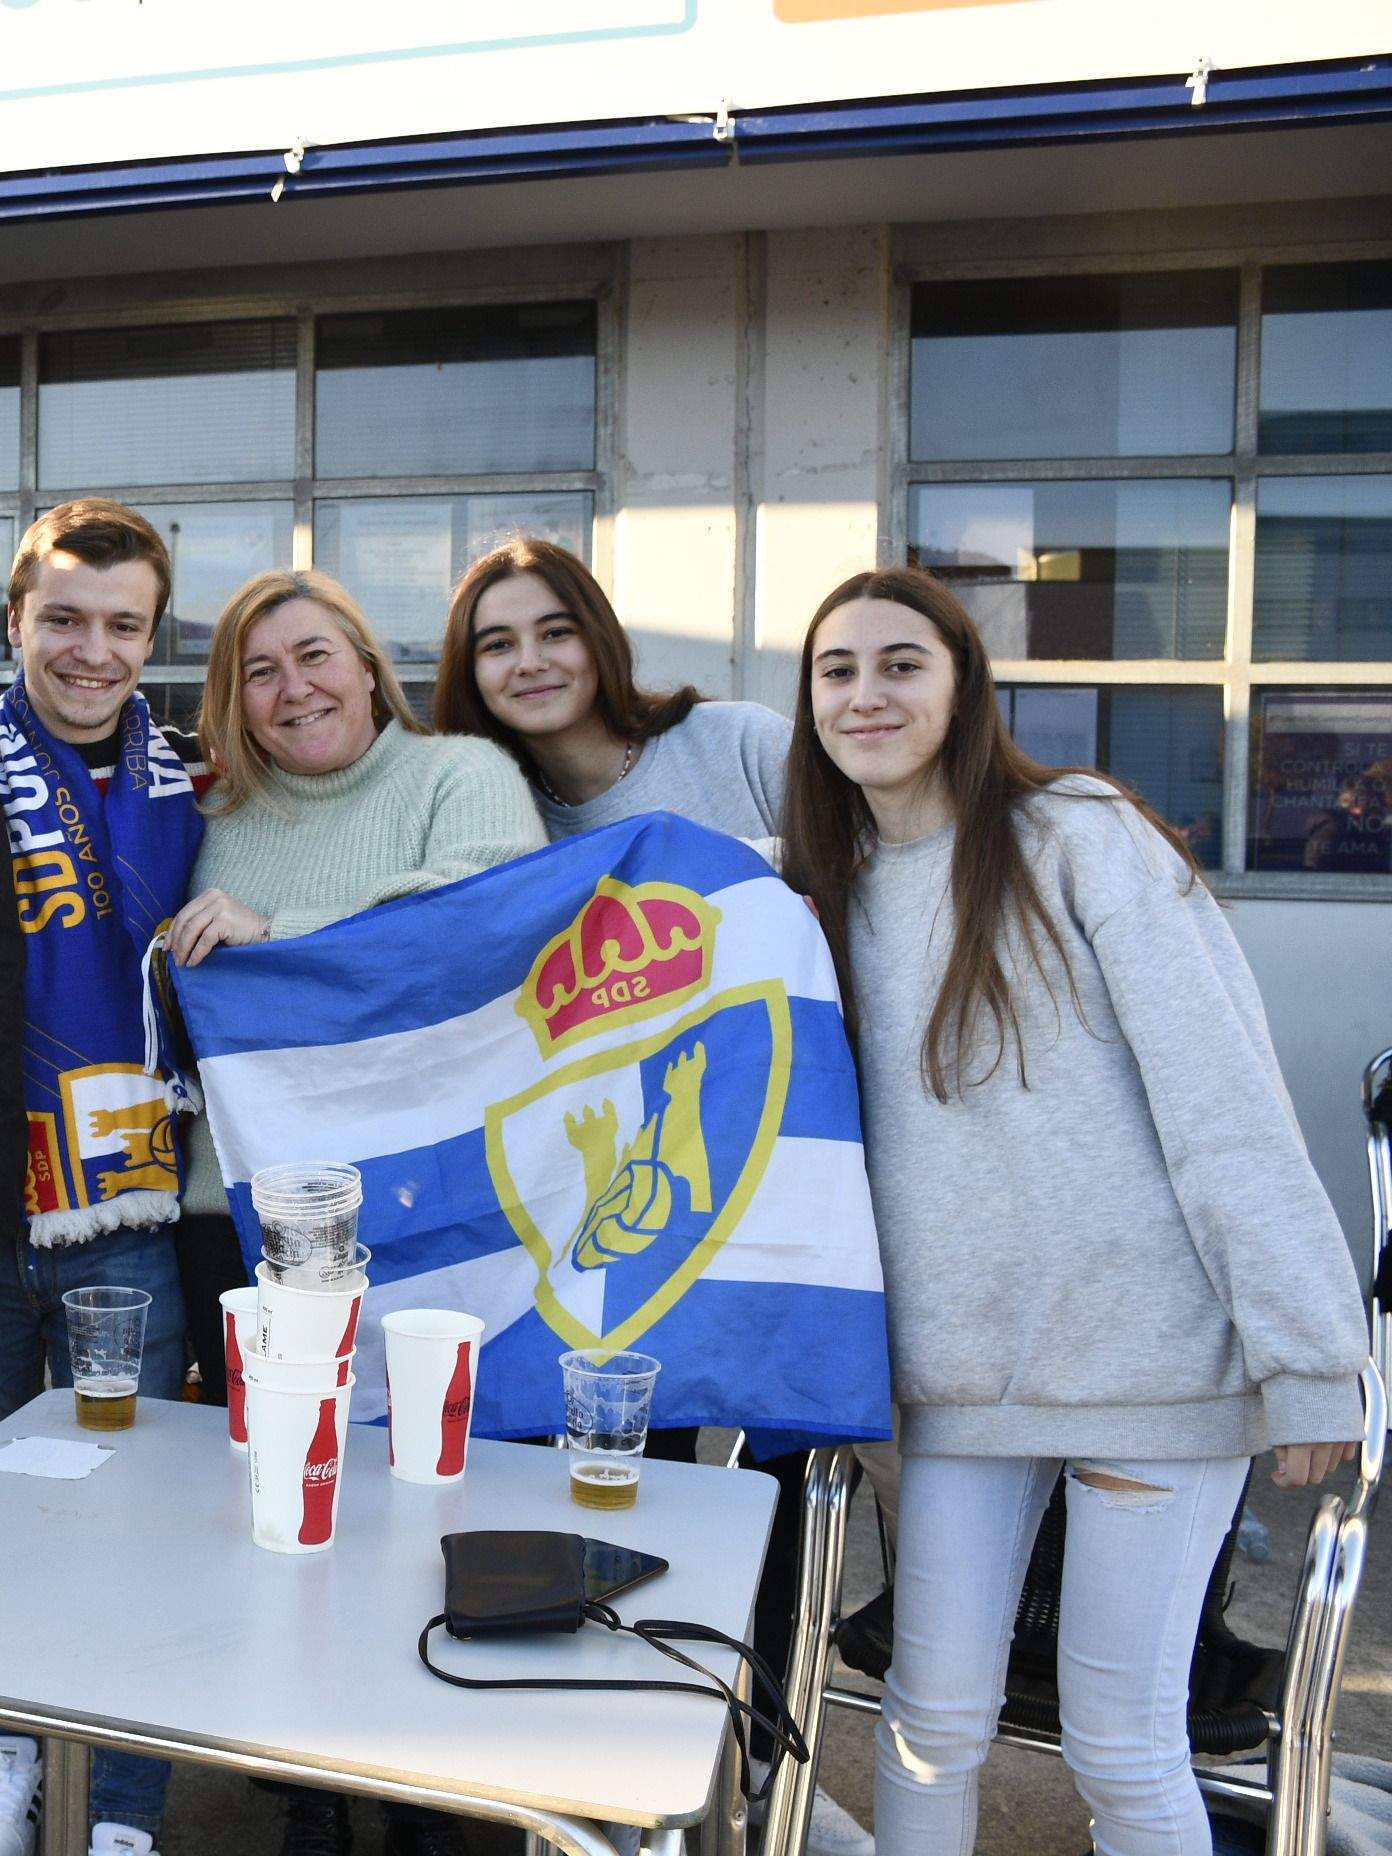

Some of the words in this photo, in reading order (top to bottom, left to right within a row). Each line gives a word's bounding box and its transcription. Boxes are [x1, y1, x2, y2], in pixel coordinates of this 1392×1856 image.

[54, 787, 98, 863] AÑOS
[88, 871, 112, 920] 100
[36, 1150, 51, 1182] SDP
